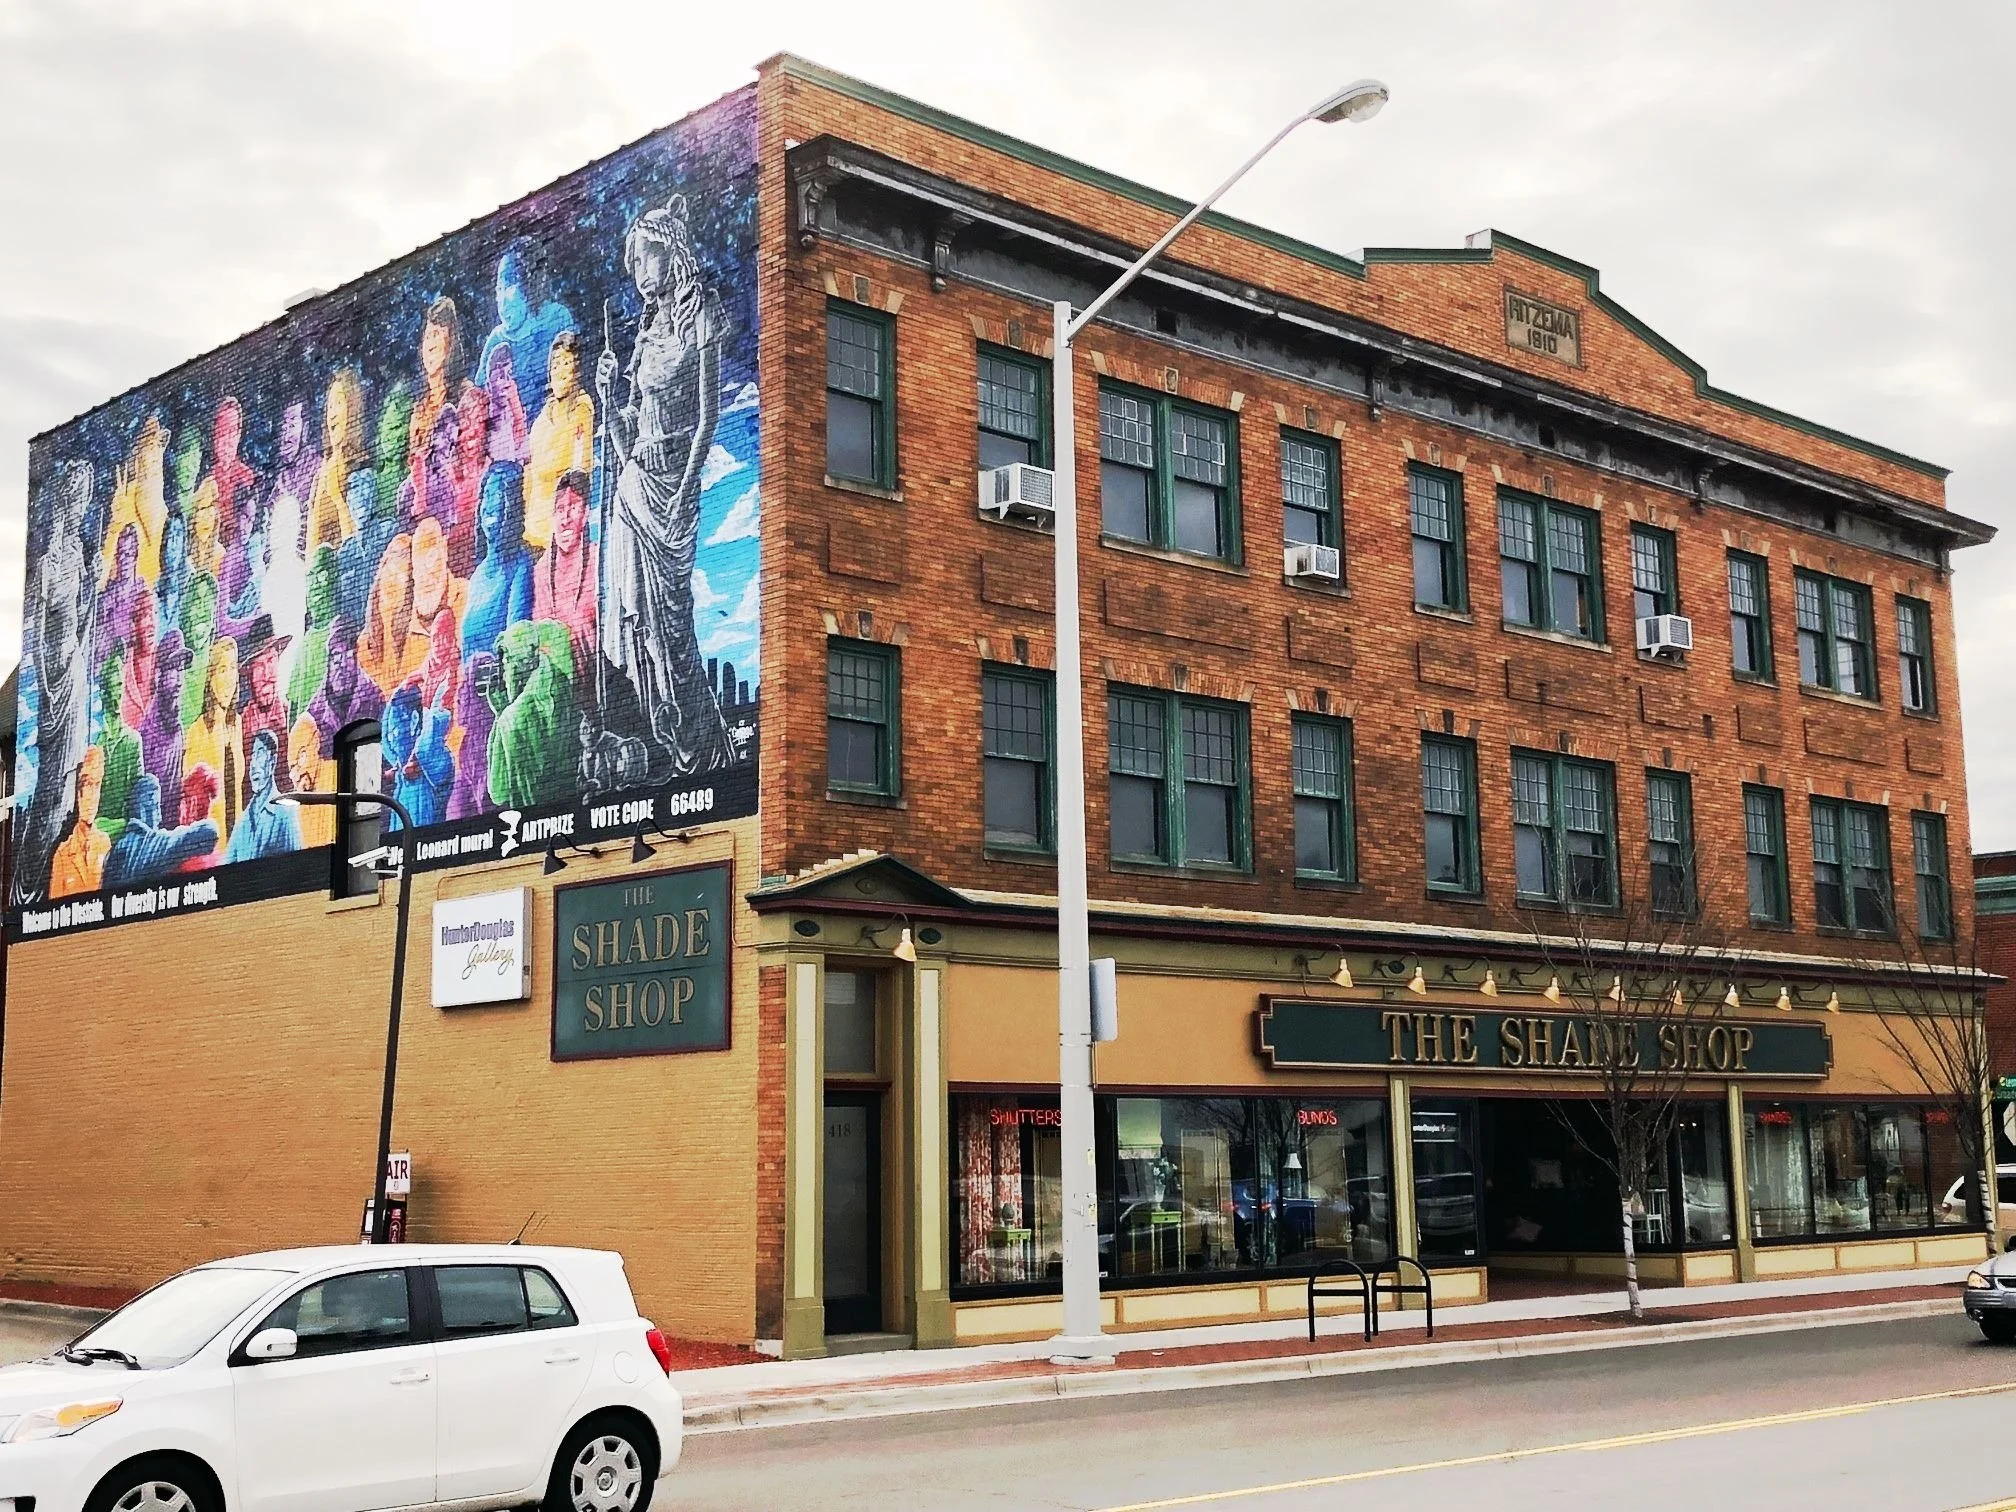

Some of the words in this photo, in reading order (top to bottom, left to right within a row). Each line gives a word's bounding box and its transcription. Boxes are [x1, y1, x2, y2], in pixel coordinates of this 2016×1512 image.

[521, 812, 575, 843] ARTPRIZE
[590, 804, 620, 829] VOTE
[622, 798, 654, 824] CODE
[670, 787, 714, 817] 66489
[416, 834, 460, 861] Leonard
[460, 828, 495, 854] mural
[624, 885, 655, 907] THE
[572, 908, 711, 972] SHADE
[584, 976, 696, 1033] SHOP
[1382, 1011, 1478, 1064] THE
[1501, 1017, 1640, 1068] SHADE
[1659, 1023, 1754, 1071] SHOP
[828, 1123, 851, 1137] 418
[990, 1109, 1062, 1126] SHUTTERS
[386, 1160, 408, 1180] AIR
